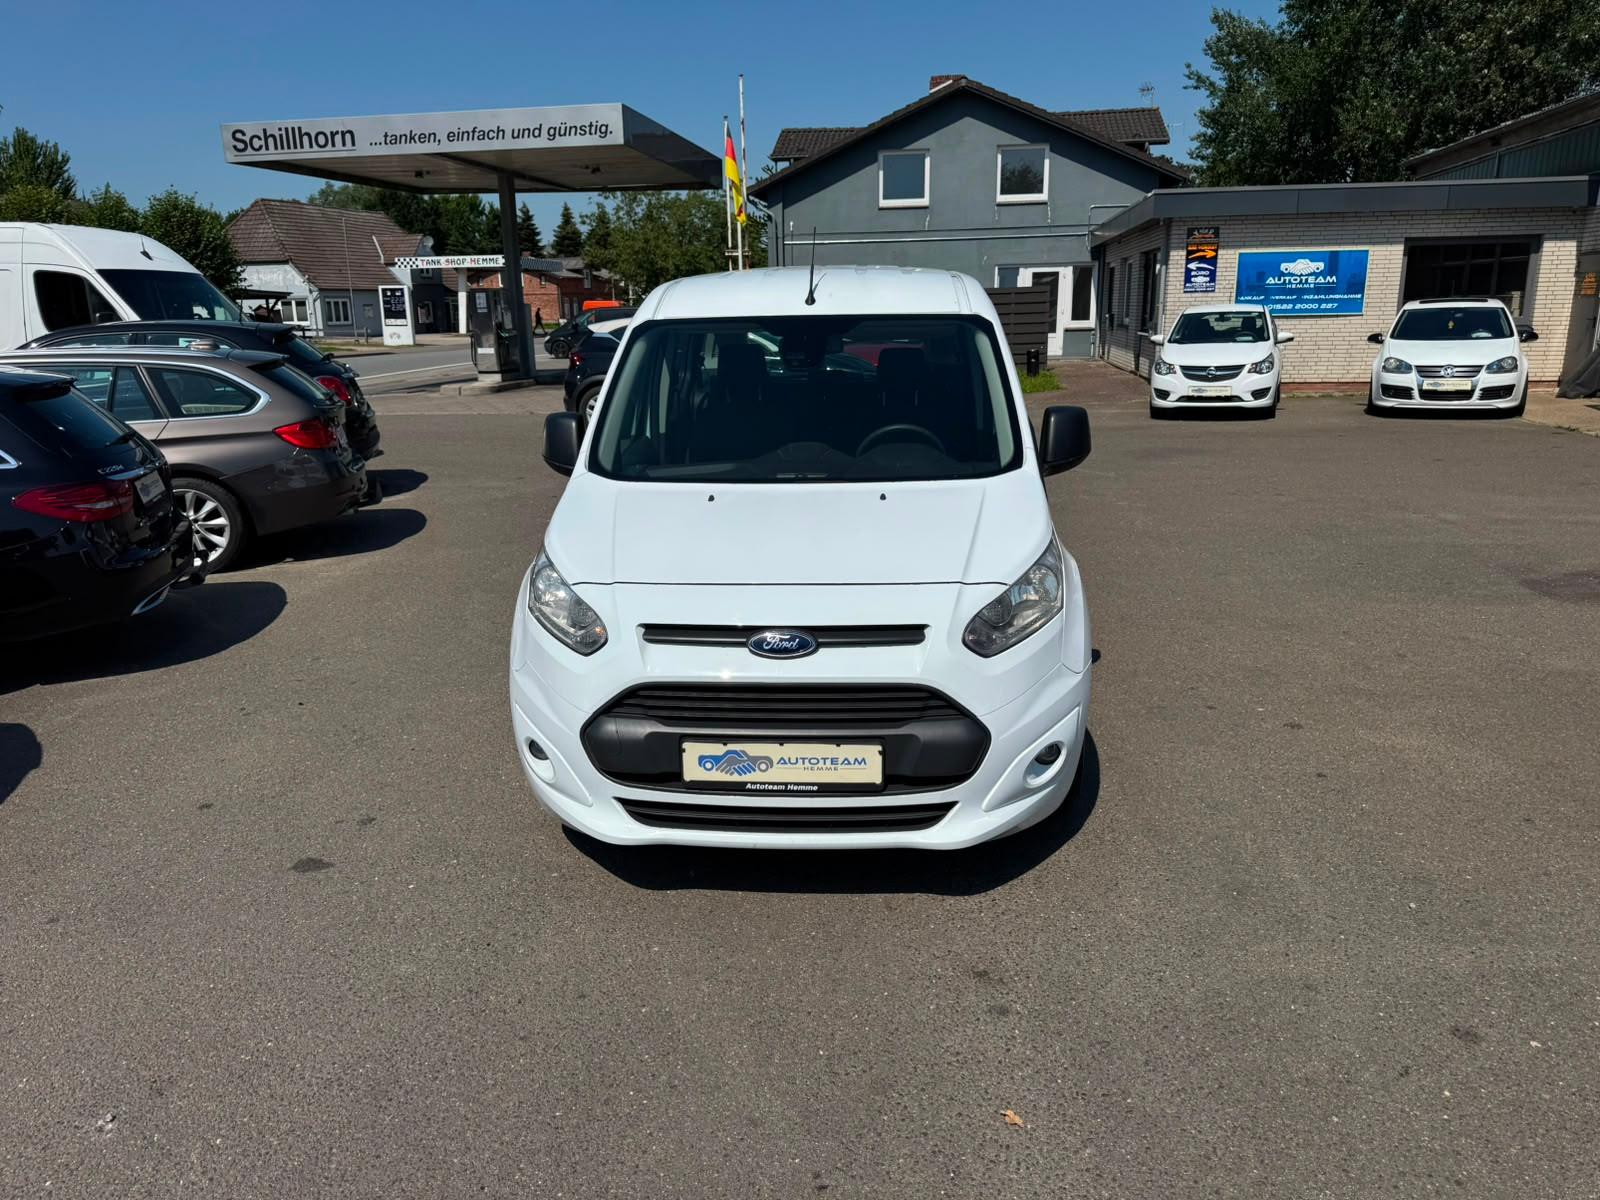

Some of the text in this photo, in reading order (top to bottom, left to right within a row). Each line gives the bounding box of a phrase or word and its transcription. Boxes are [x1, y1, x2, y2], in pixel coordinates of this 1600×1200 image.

[231, 120, 613, 153] Schillhorn ...tanken, einfach und günstig.
[420, 259, 443, 267] TANK
[470, 257, 501, 265] HEMME
[1265, 275, 1337, 284] AUTOTEAM
[762, 632, 800, 650] Ford
[776, 756, 867, 766] AUTOTEAM
[745, 782, 819, 792] Autoteam Hemme
